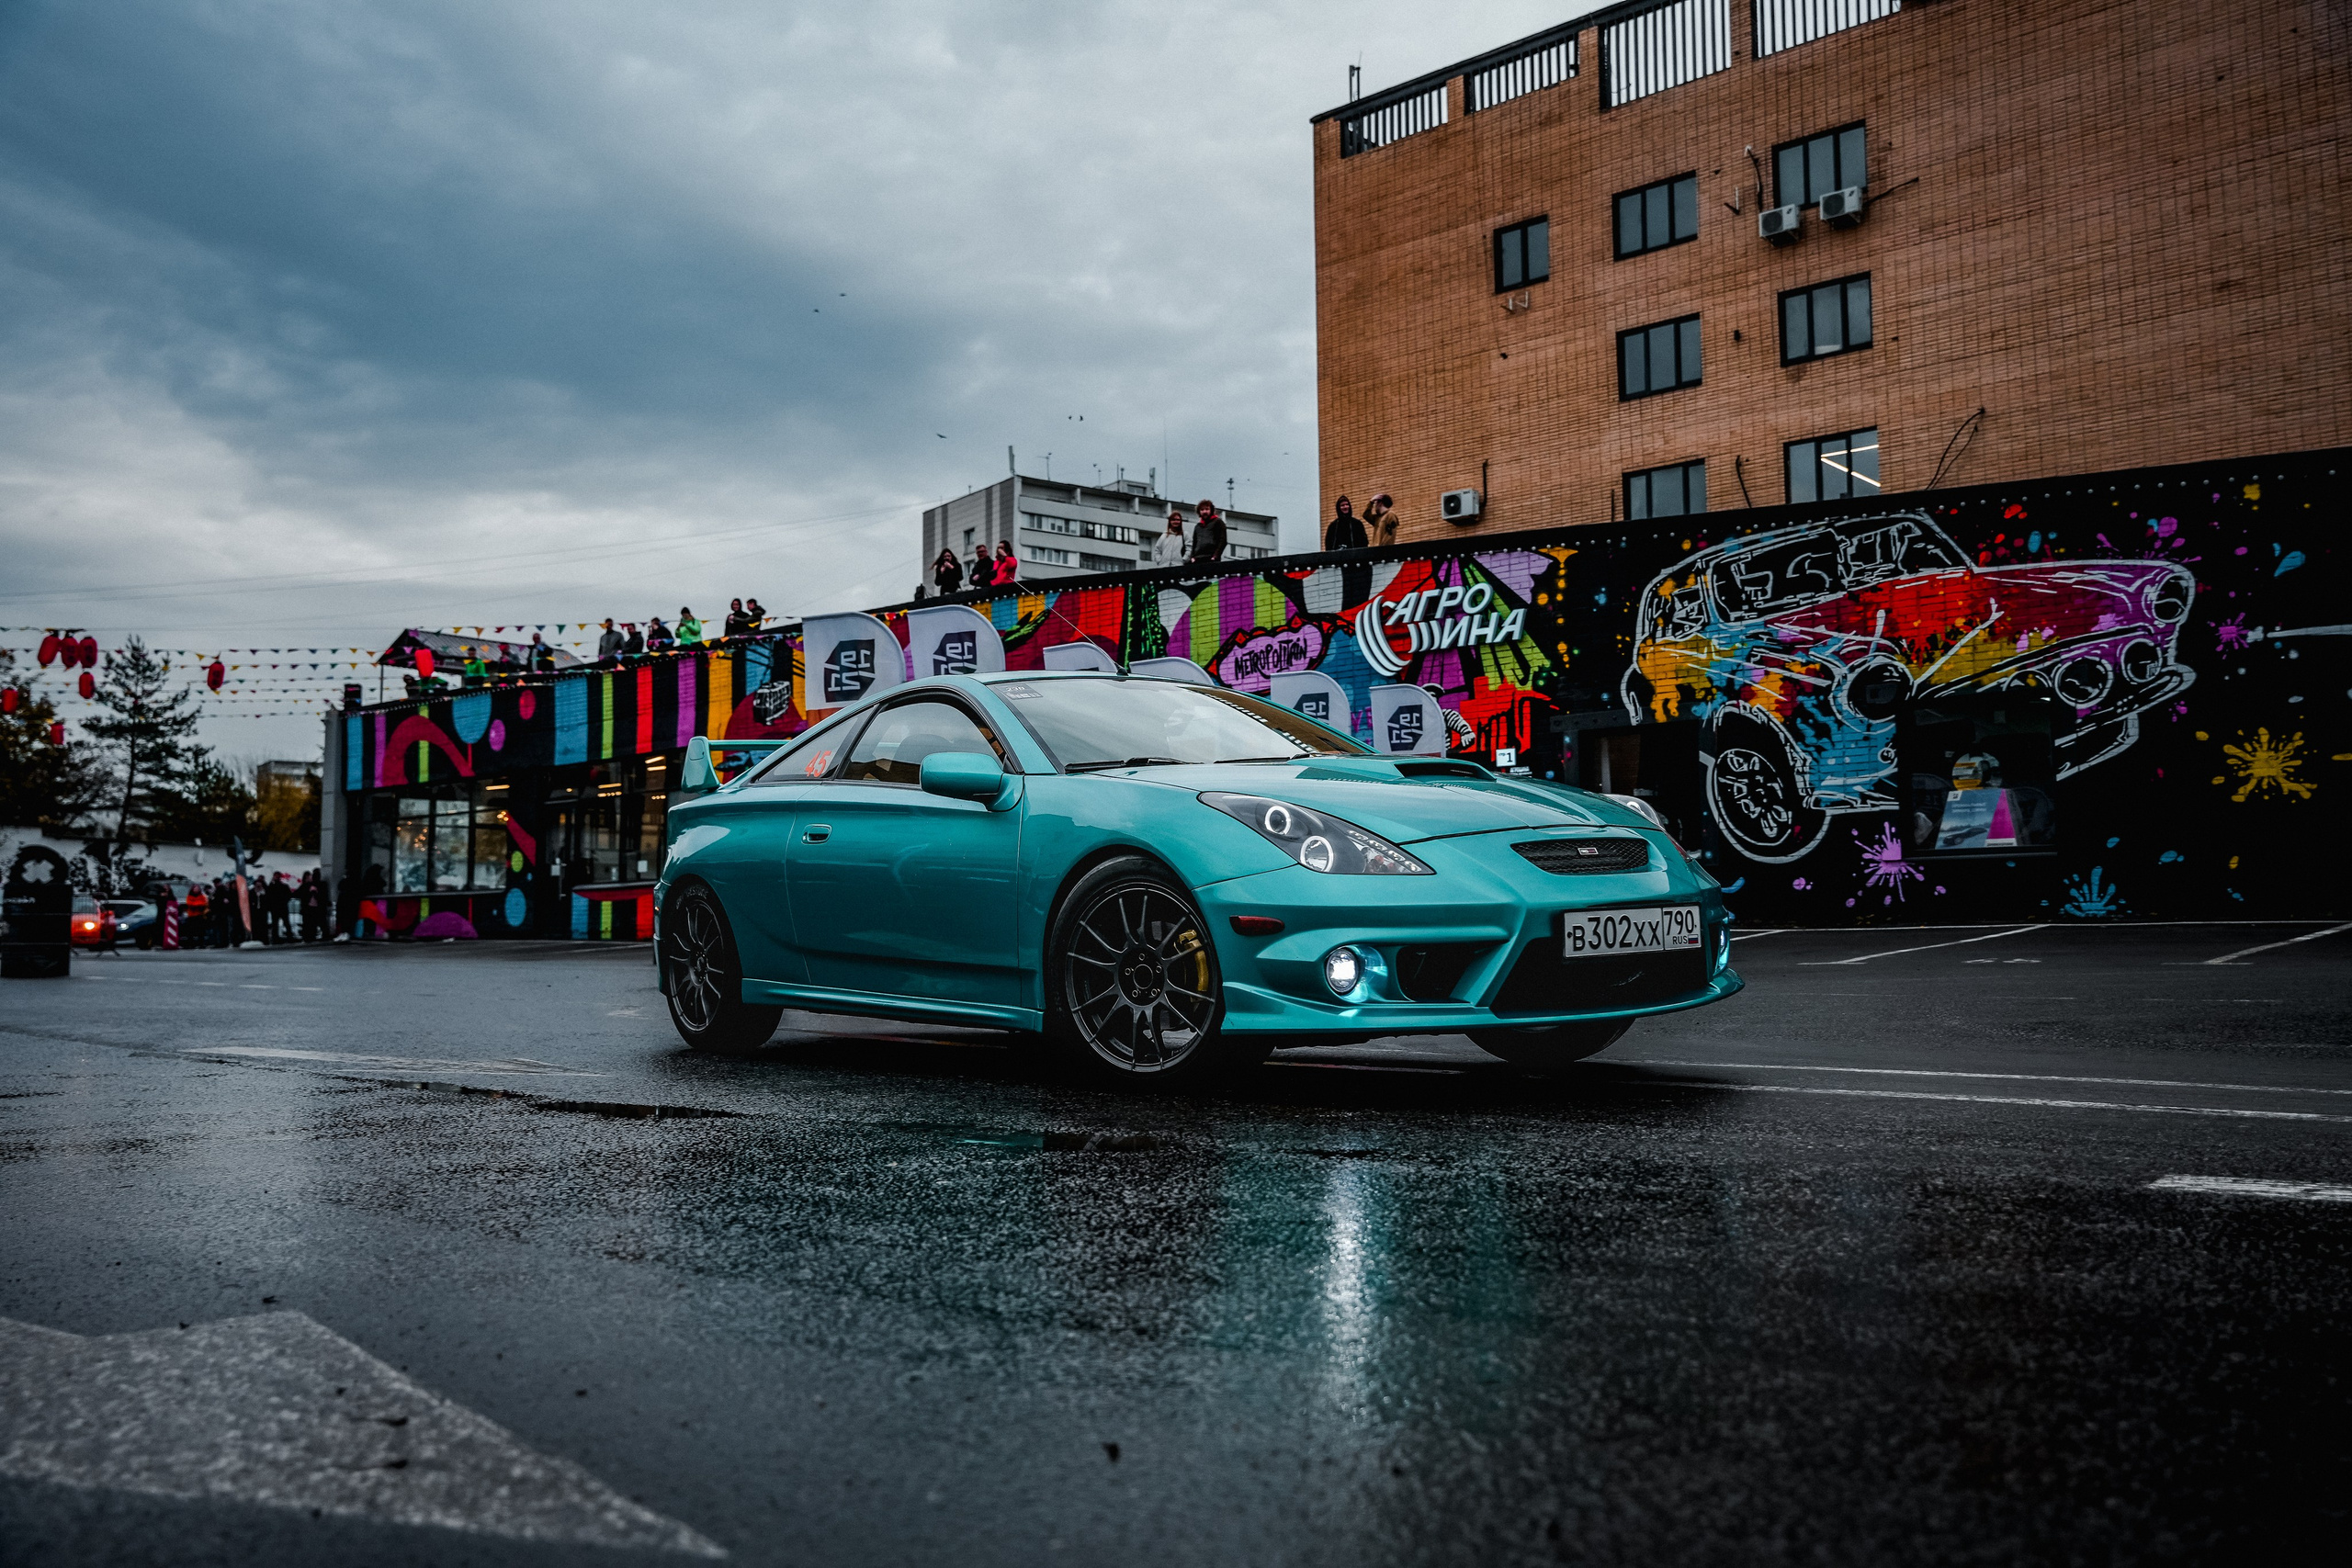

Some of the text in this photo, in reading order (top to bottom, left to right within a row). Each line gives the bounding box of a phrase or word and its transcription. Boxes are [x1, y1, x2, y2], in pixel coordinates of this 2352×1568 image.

[1383, 582, 1494, 626] АГРО
[1408, 608, 1527, 653] ШИНА
[804, 750, 831, 777] 45
[1507, 752, 1513, 762] 1
[1572, 910, 1694, 952] В302ХХ 790
[1672, 935, 1688, 945] RUS
